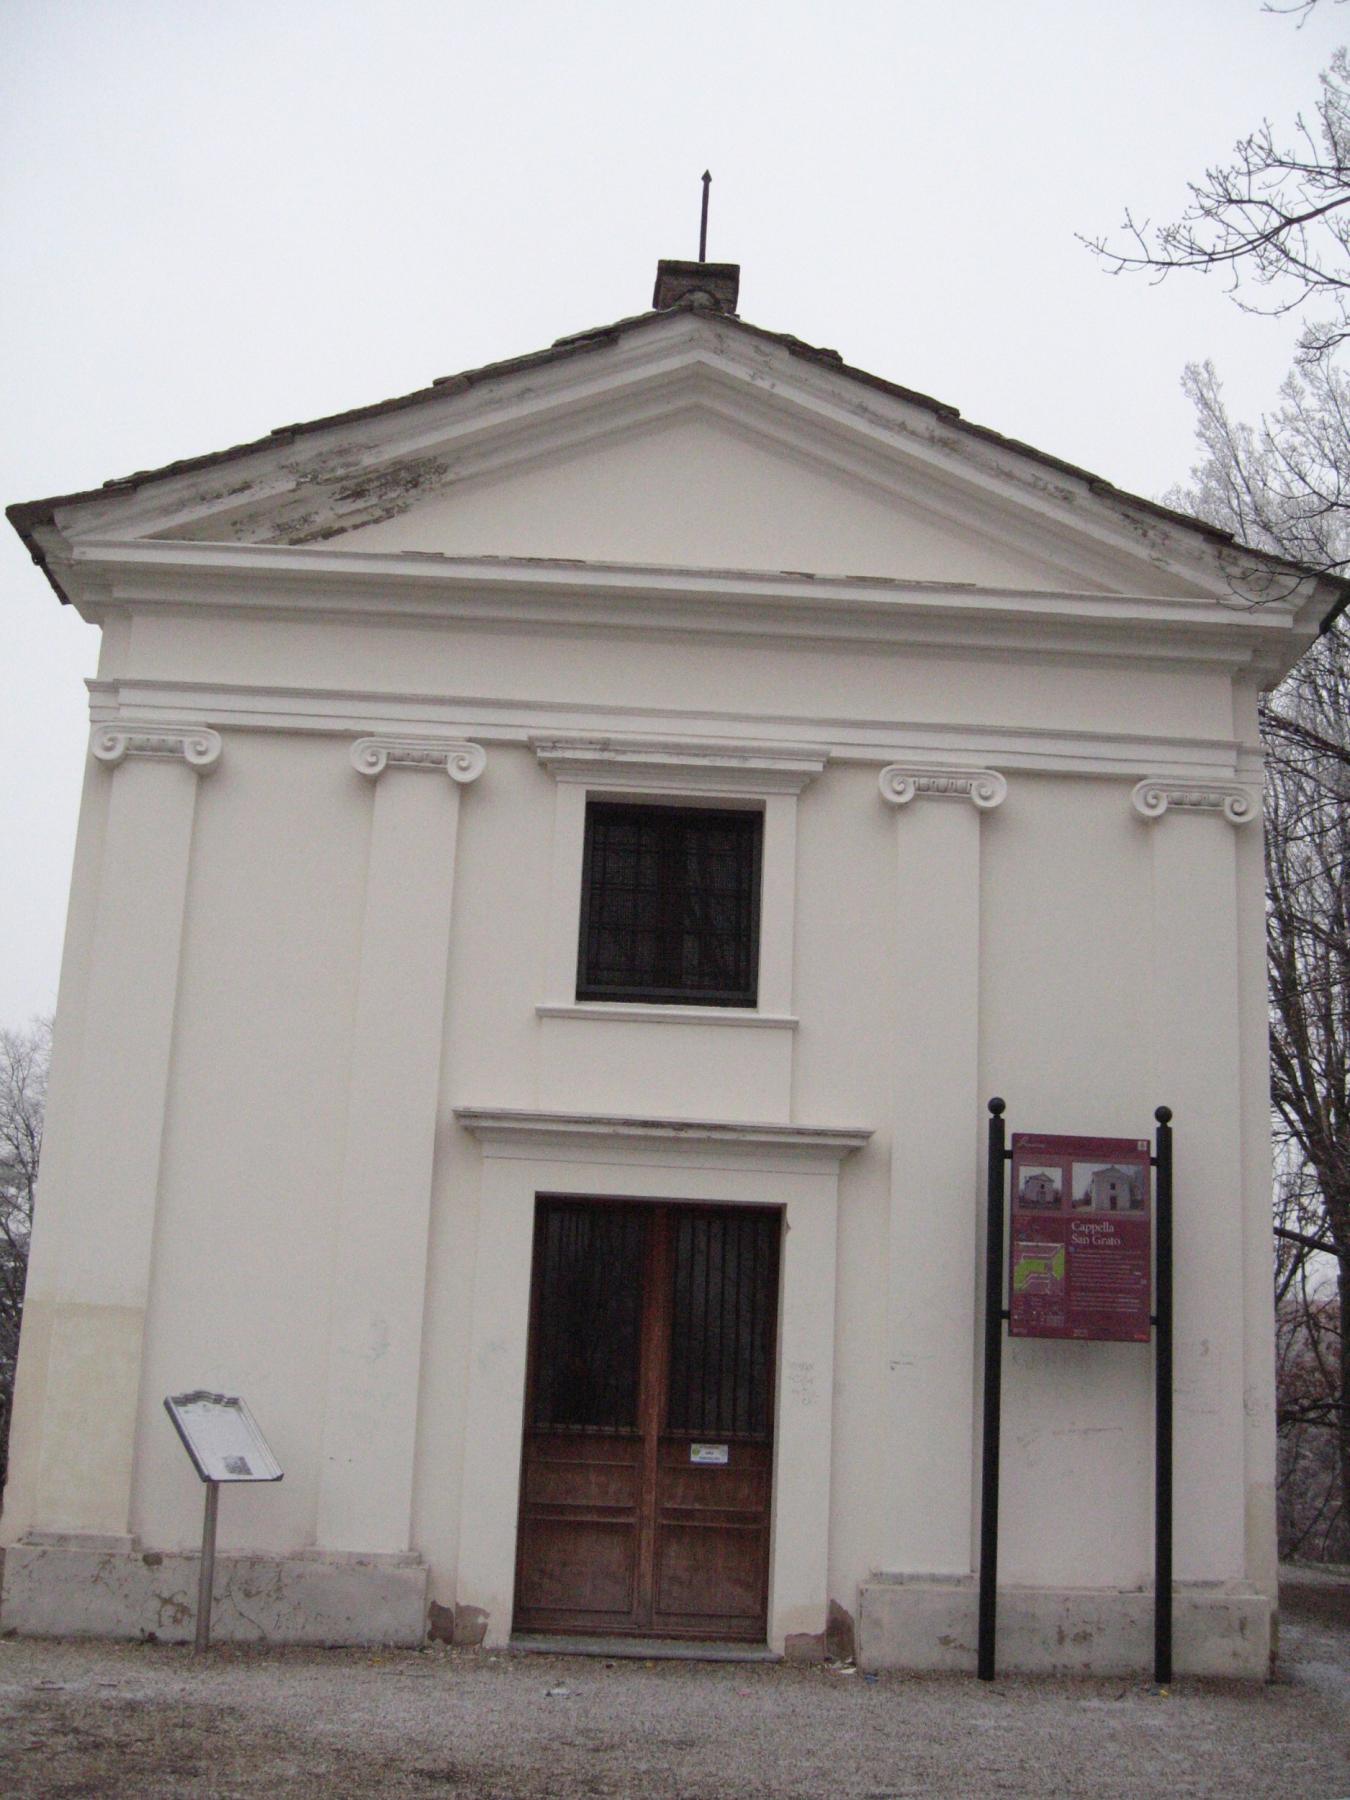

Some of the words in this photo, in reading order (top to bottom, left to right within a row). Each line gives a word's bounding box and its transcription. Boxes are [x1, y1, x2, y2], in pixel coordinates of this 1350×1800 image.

[1071, 1221, 1114, 1234] Cappella
[1071, 1233, 1090, 1245] San
[1092, 1234, 1121, 1246] Grato
